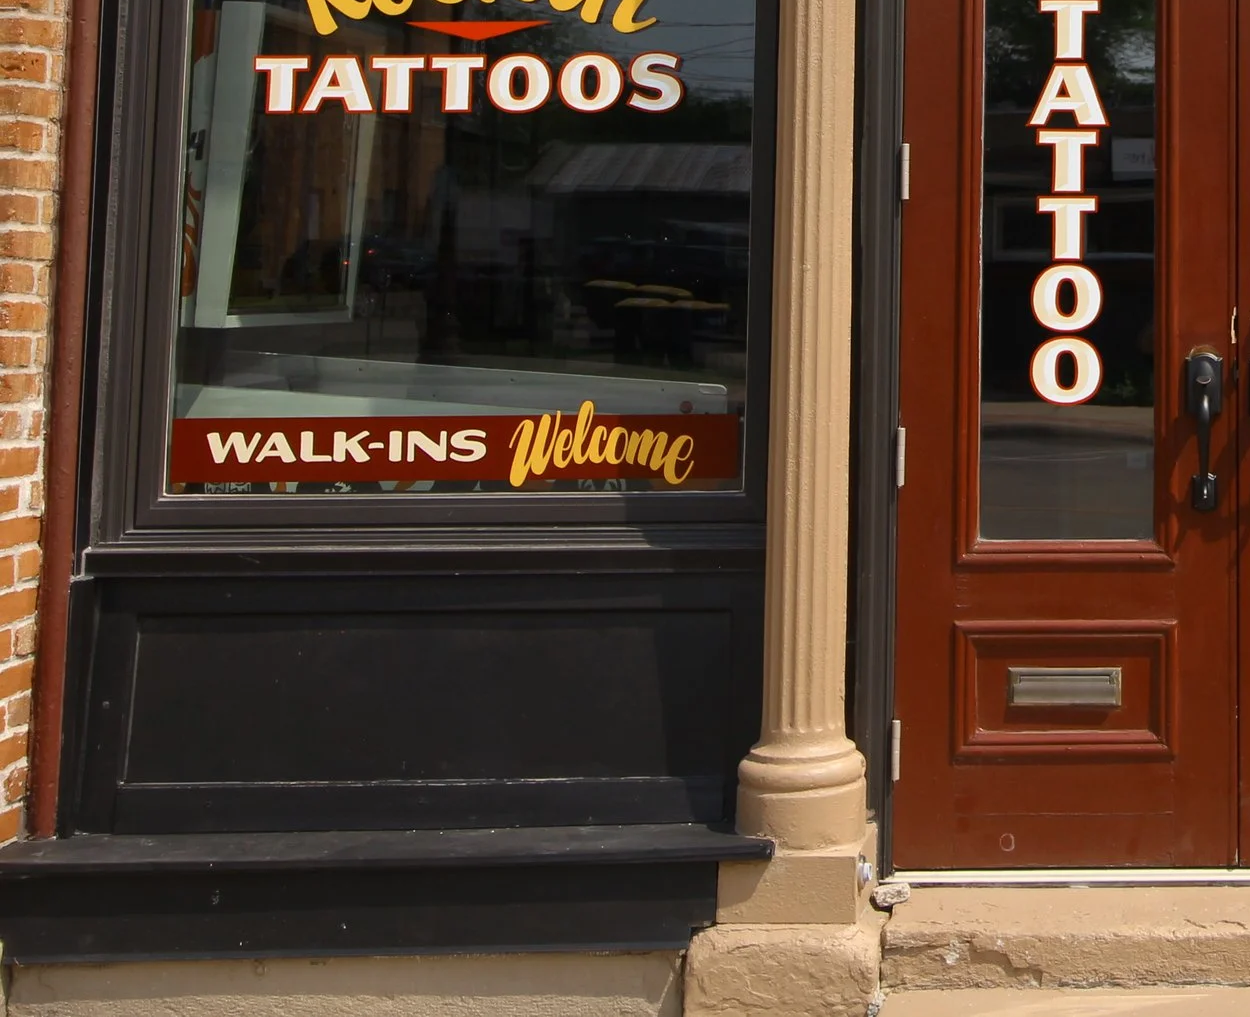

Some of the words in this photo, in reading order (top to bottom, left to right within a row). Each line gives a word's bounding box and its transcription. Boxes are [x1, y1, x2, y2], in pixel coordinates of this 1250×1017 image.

[254, 52, 685, 113] TATTOOS
[206, 429, 488, 464] WALK-INS
[509, 400, 695, 488] Welcome
